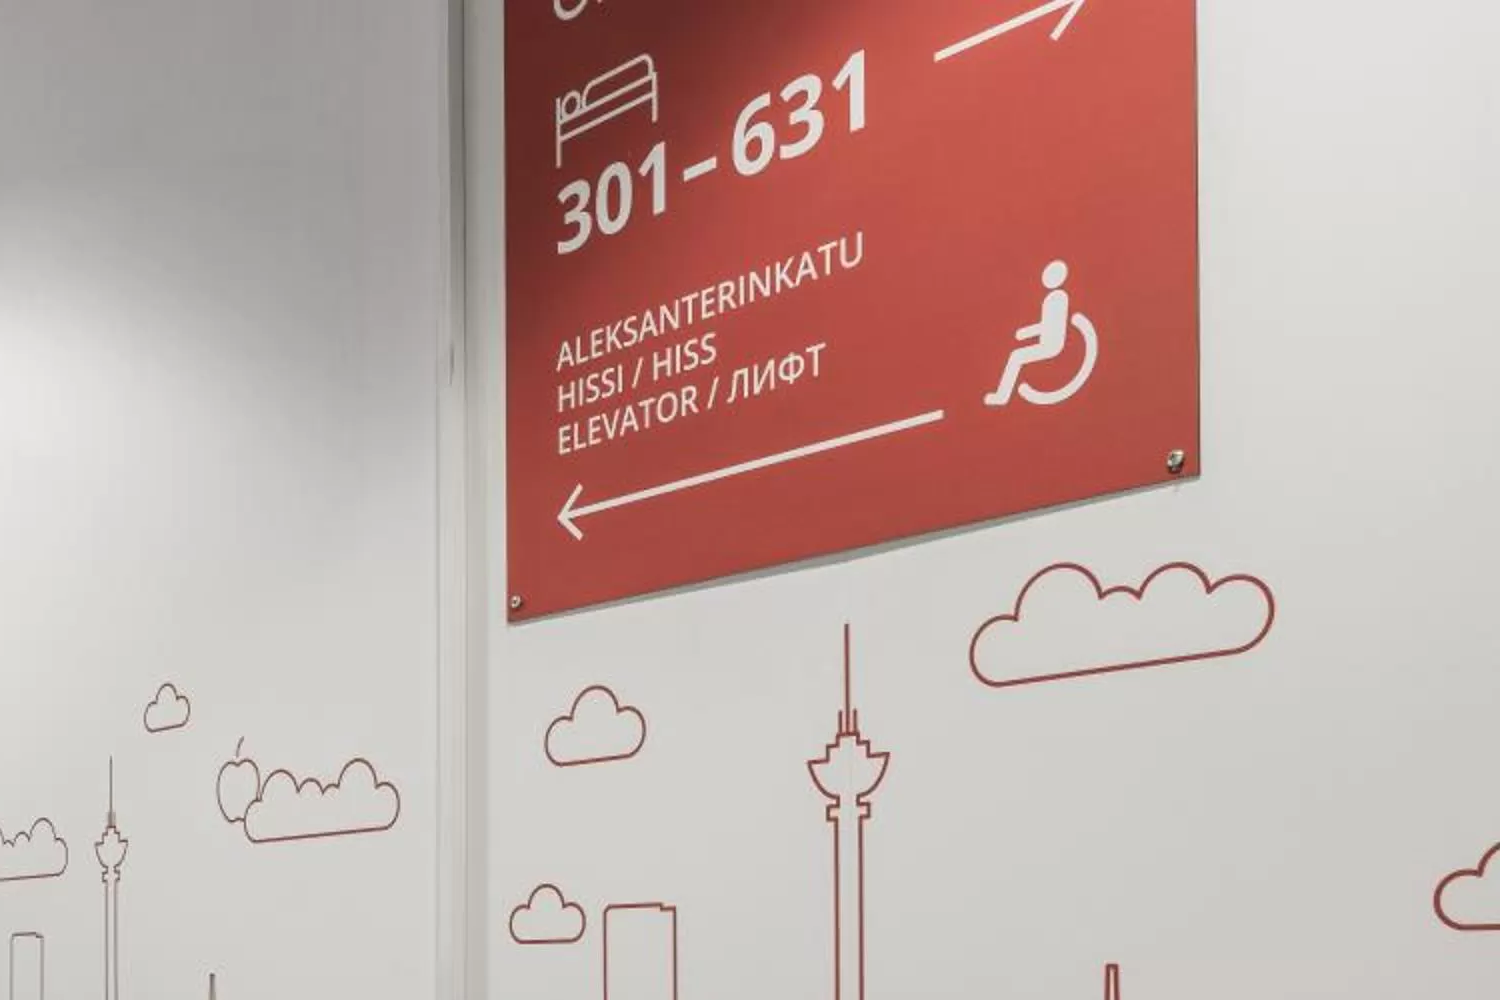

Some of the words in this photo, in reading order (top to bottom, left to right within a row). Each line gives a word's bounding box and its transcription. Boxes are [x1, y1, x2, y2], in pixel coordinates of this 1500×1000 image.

[556, 231, 863, 372] ALEKSANTERINKATU
[558, 364, 623, 413] HISSI
[653, 333, 717, 381] HISS
[558, 385, 699, 455] ELEVATOR
[726, 342, 826, 404] ЛИФТ
